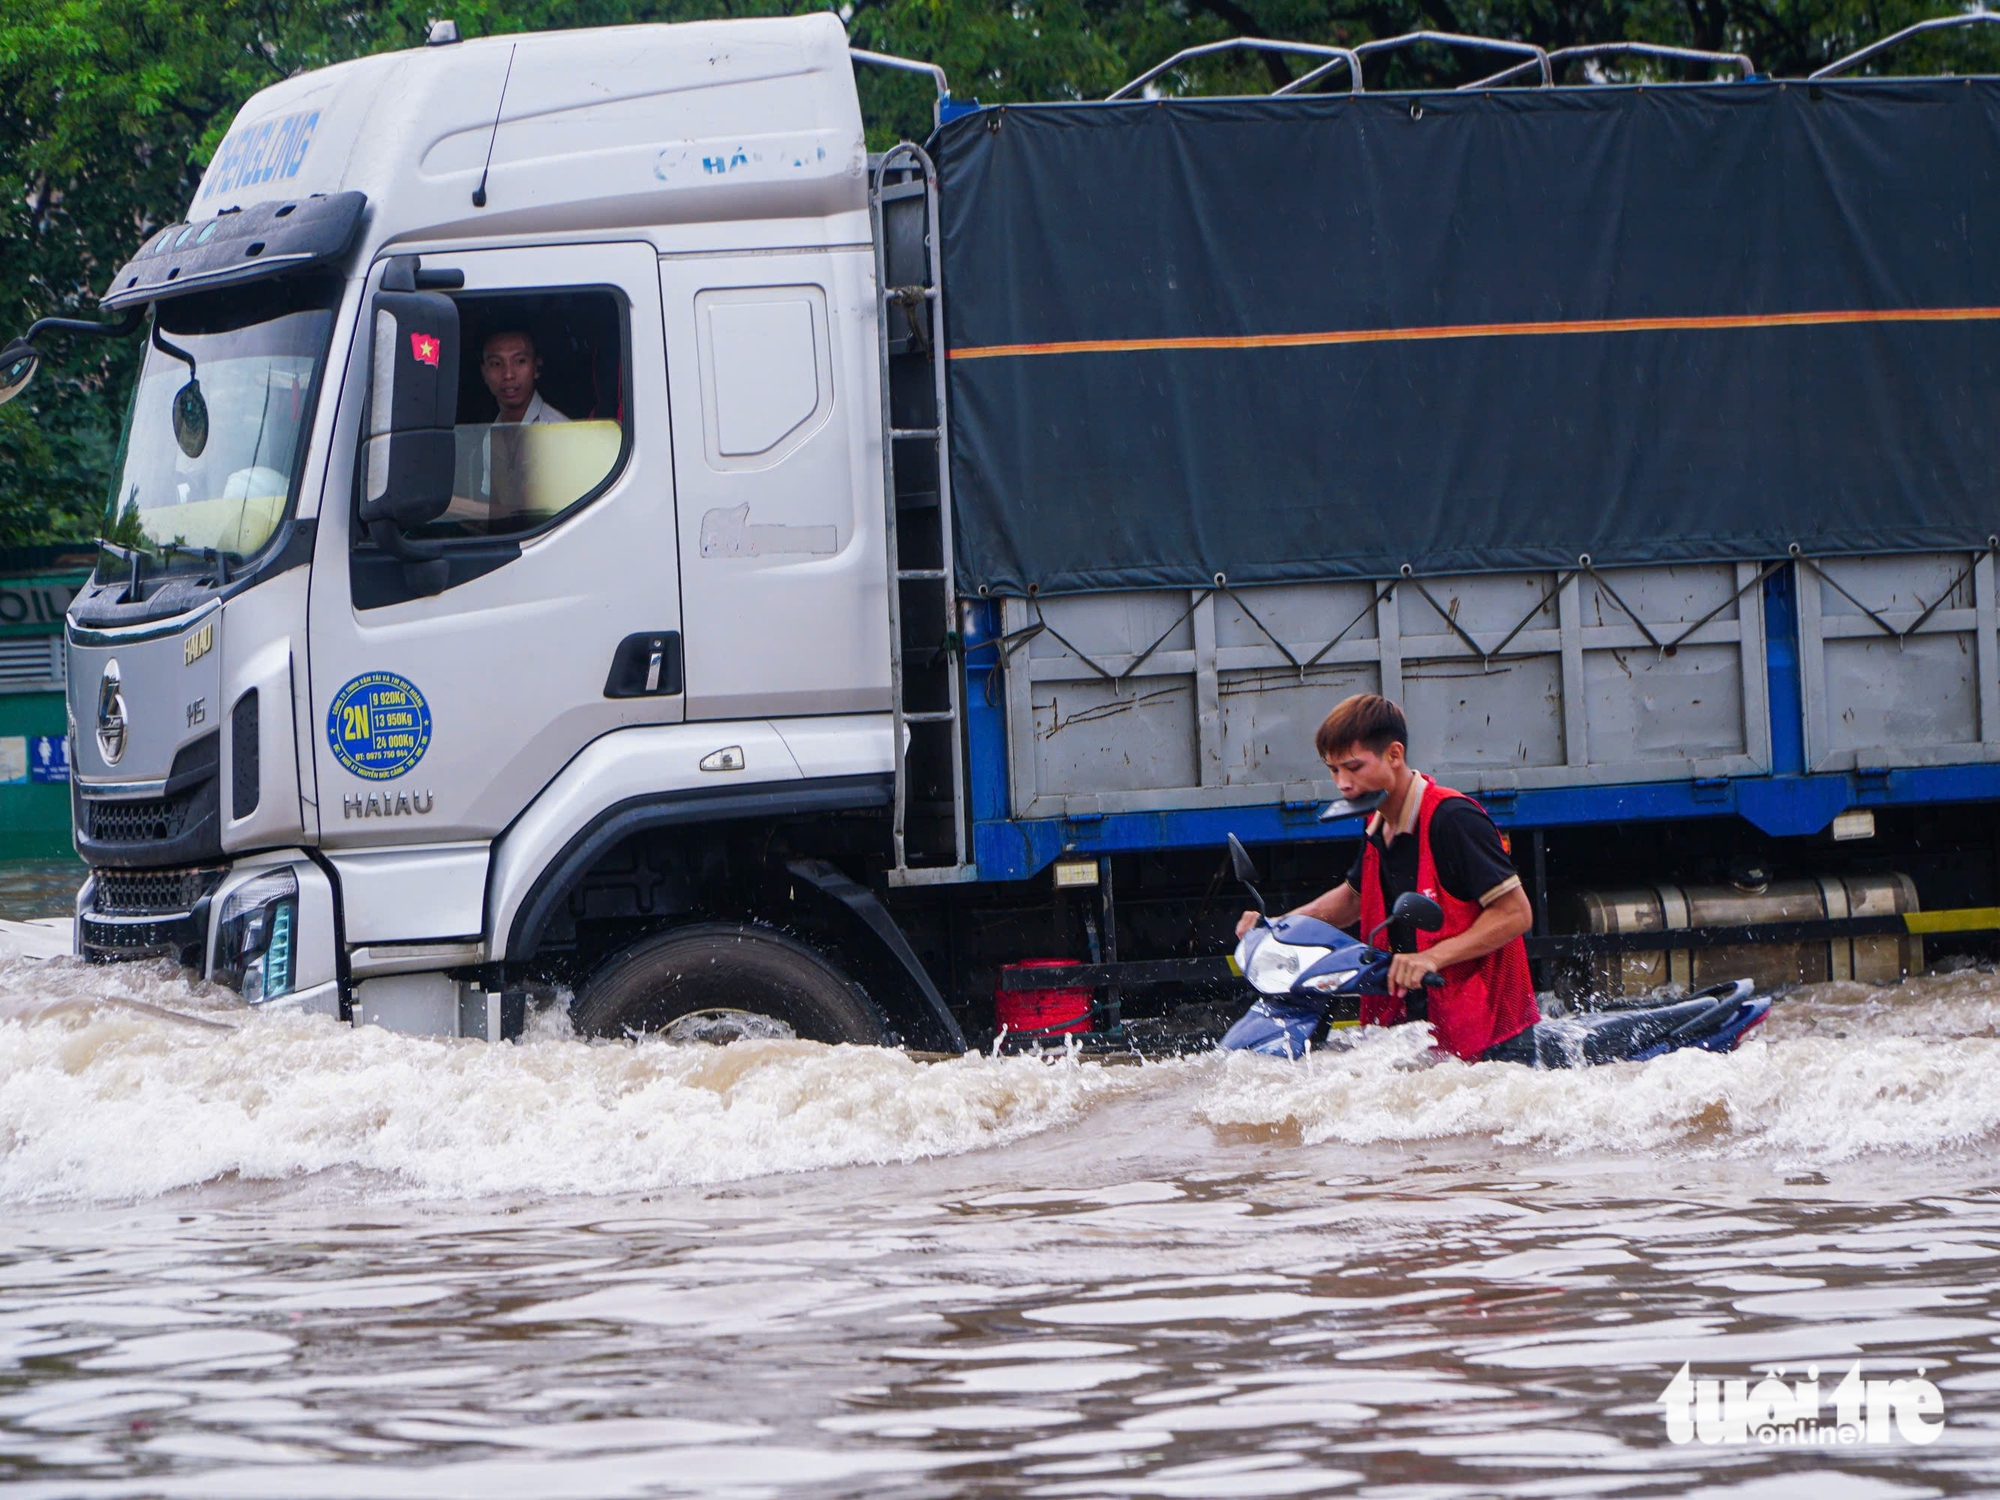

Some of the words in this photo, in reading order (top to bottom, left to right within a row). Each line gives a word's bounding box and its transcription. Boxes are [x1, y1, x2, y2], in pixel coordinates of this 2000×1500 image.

[202, 111, 320, 200] CHENGLONG
[373, 692, 378, 706] 9
[380, 690, 406, 705] 920Kg
[343, 704, 370, 741] 2N
[375, 714, 385, 727] 13
[387, 712, 413, 725] 950Kg
[376, 735, 387, 750] 24
[388, 733, 414, 748] 000Kg
[343, 788, 434, 820] HAIAU
